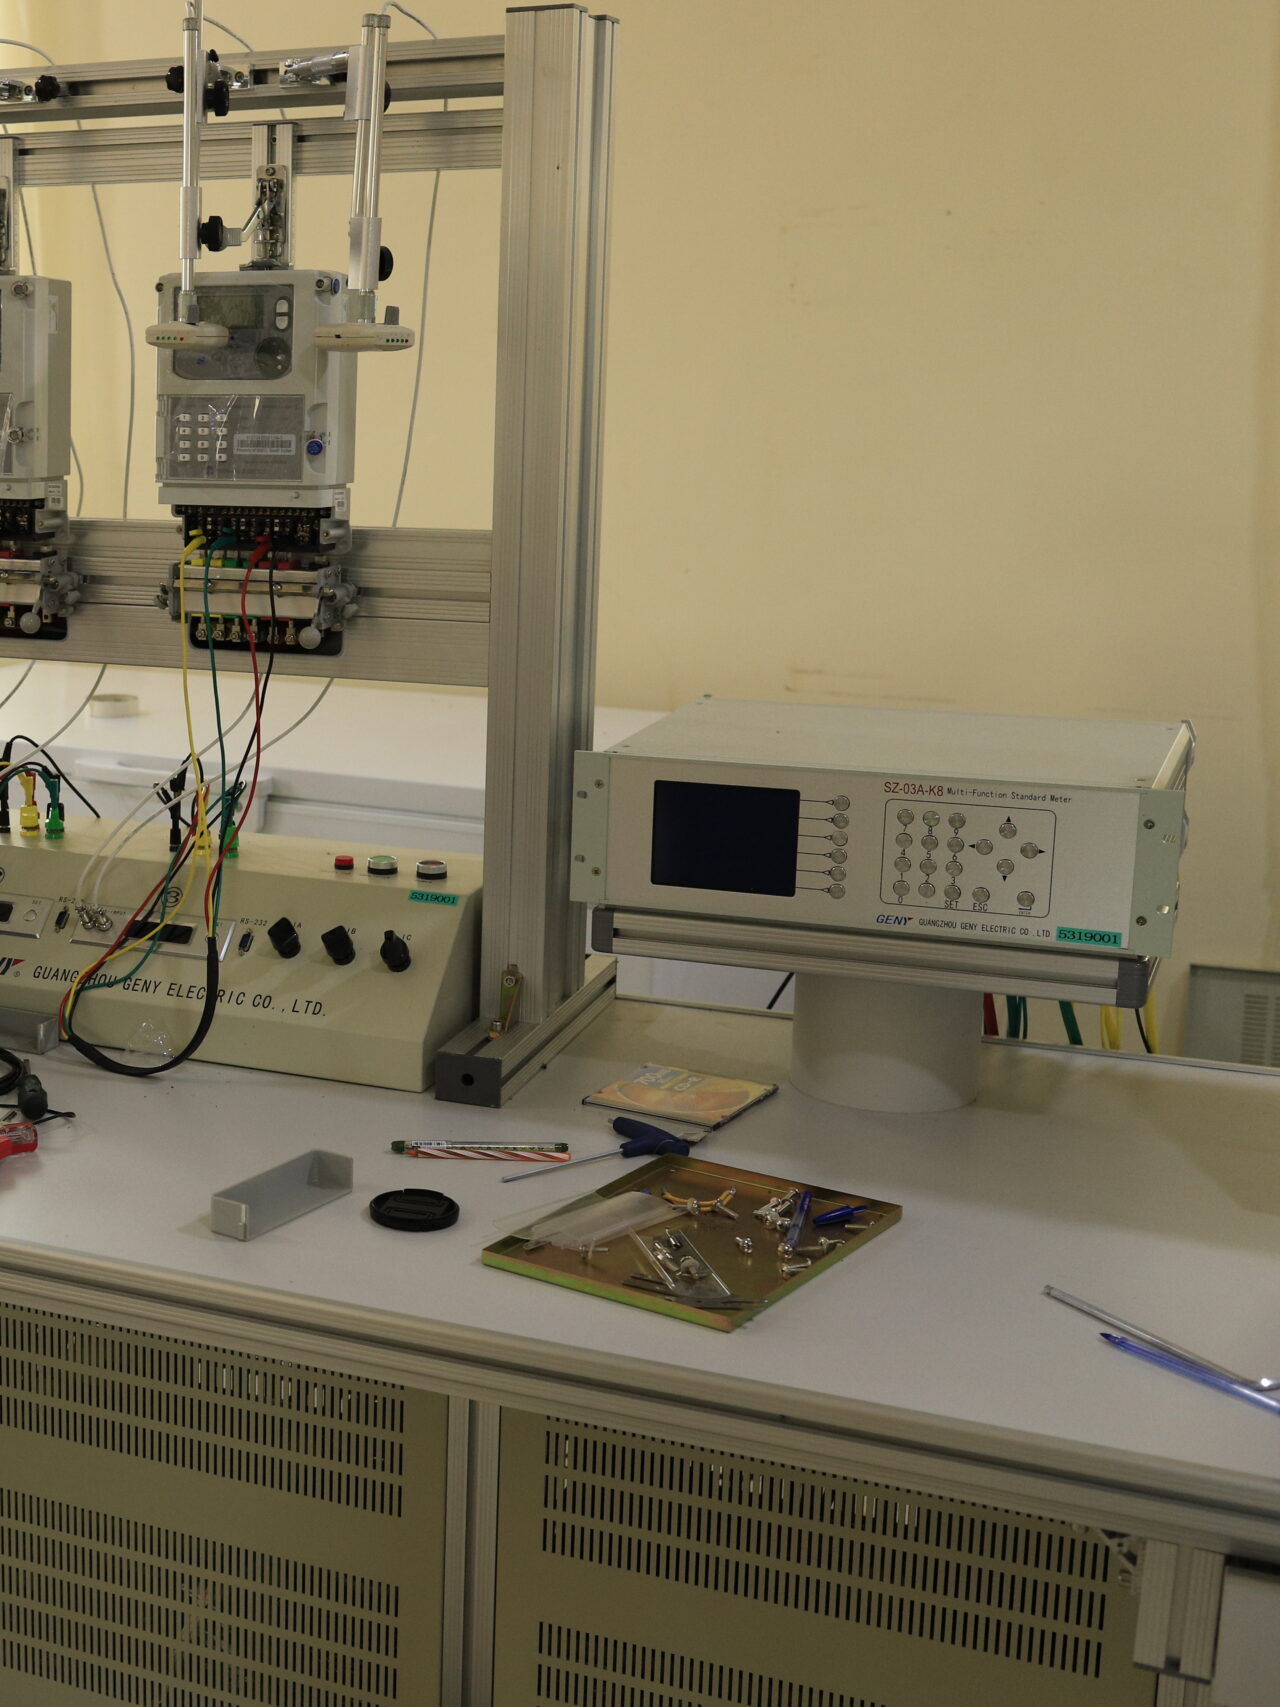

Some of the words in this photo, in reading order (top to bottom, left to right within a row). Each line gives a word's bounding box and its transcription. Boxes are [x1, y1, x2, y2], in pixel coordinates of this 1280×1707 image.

[884, 781, 944, 797] SZ-03A-K8
[947, 788, 1007, 799] Multi-Function
[1011, 791, 1046, 802] Standard
[1050, 795, 1072, 804] Meter
[928, 826, 933, 834] 8
[953, 827, 959, 836] 9
[926, 851, 932, 859] 5
[952, 853, 958, 861] 6
[951, 876, 956, 884] 3
[410, 891, 457, 904] 5319001
[897, 896, 903, 904] 0
[944, 900, 959, 909] SET
[972, 902, 988, 912] ESC
[240, 918, 268, 926] RS-232
[876, 914, 914, 926] GENY
[918, 917, 957, 929] GUANGZHOU
[960, 921, 978, 931] GENY
[981, 923, 1016, 935] ELECTRIC
[1057, 928, 1119, 945] 5319001
[33, 965, 117, 988] GUANGHOU
[122, 977, 162, 994] GENY
[166, 982, 245, 1006] ELECRIC
[291, 999, 326, 1017] LTD.
